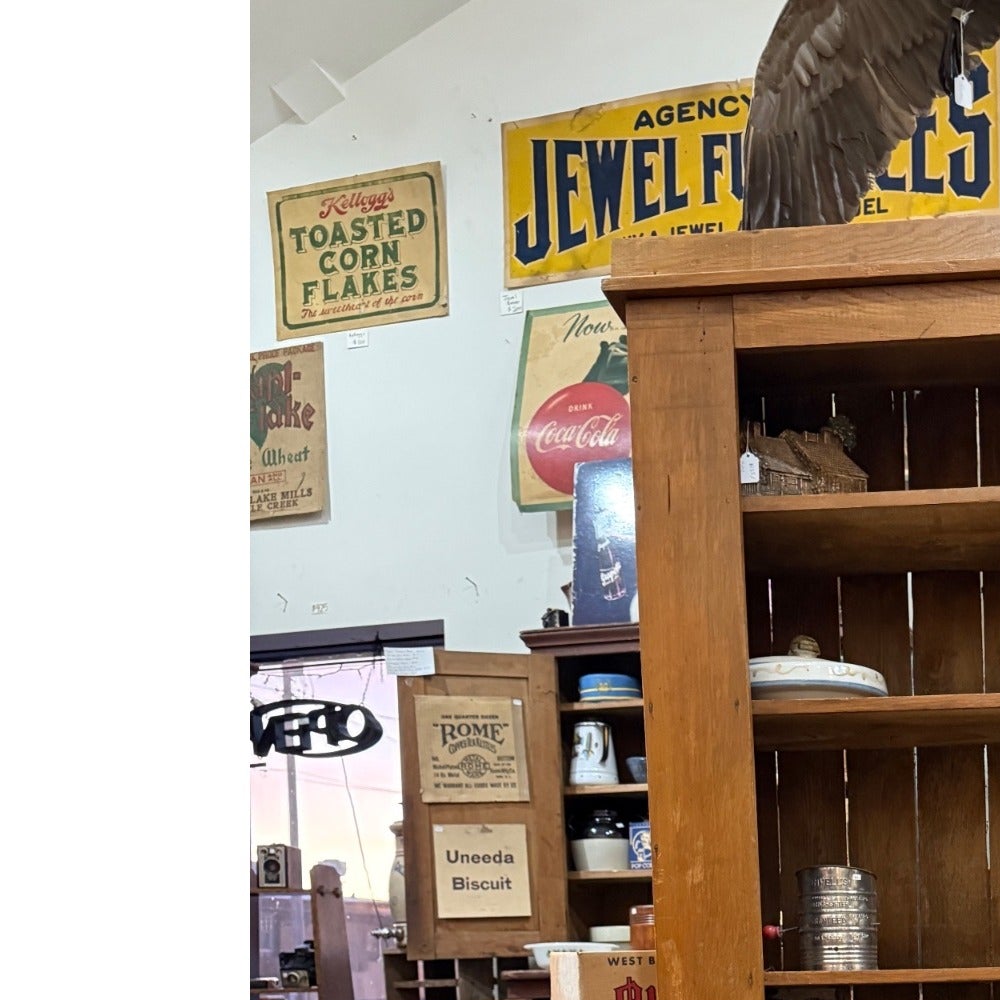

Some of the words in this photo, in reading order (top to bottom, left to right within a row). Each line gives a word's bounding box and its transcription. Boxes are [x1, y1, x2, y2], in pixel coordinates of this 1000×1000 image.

[319, 187, 395, 219] Kellogg's
[513, 137, 689, 265] JEWEL
[289, 208, 427, 254] TOASTED
[318, 240, 402, 276] CORN
[302, 264, 419, 307] FLAKES
[301, 308, 318, 319] The
[385, 295, 399, 306] the
[401, 293, 424, 303] corn
[568, 402, 593, 413] DRINK
[262, 445, 311, 467] Wheat
[281, 487, 313, 500] MILLS
[267, 499, 299, 511] CREEK
[446, 850, 515, 864] Uneeda
[452, 877, 513, 891] Biscuit
[608, 956, 643, 967] WEST
